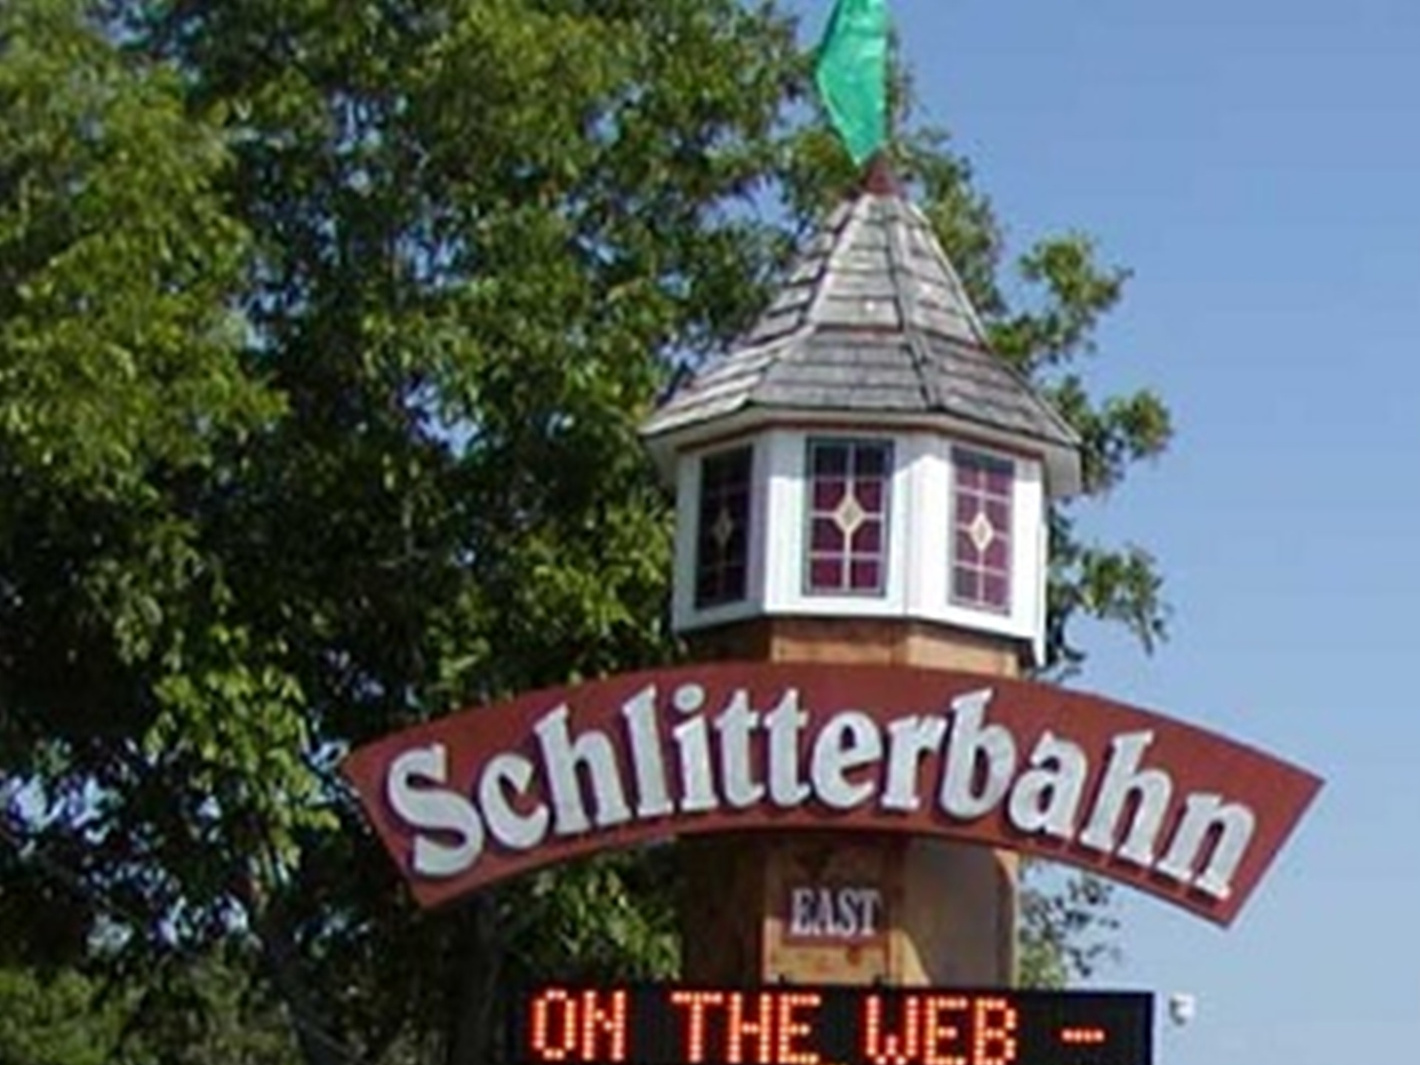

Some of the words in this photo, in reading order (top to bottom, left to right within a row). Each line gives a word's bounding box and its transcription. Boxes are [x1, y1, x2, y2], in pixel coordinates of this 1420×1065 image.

[386, 683, 1259, 900] Schlitterbahn
[789, 888, 882, 938] EAST
[532, 988, 626, 1063] ON
[670, 991, 823, 1065] THE
